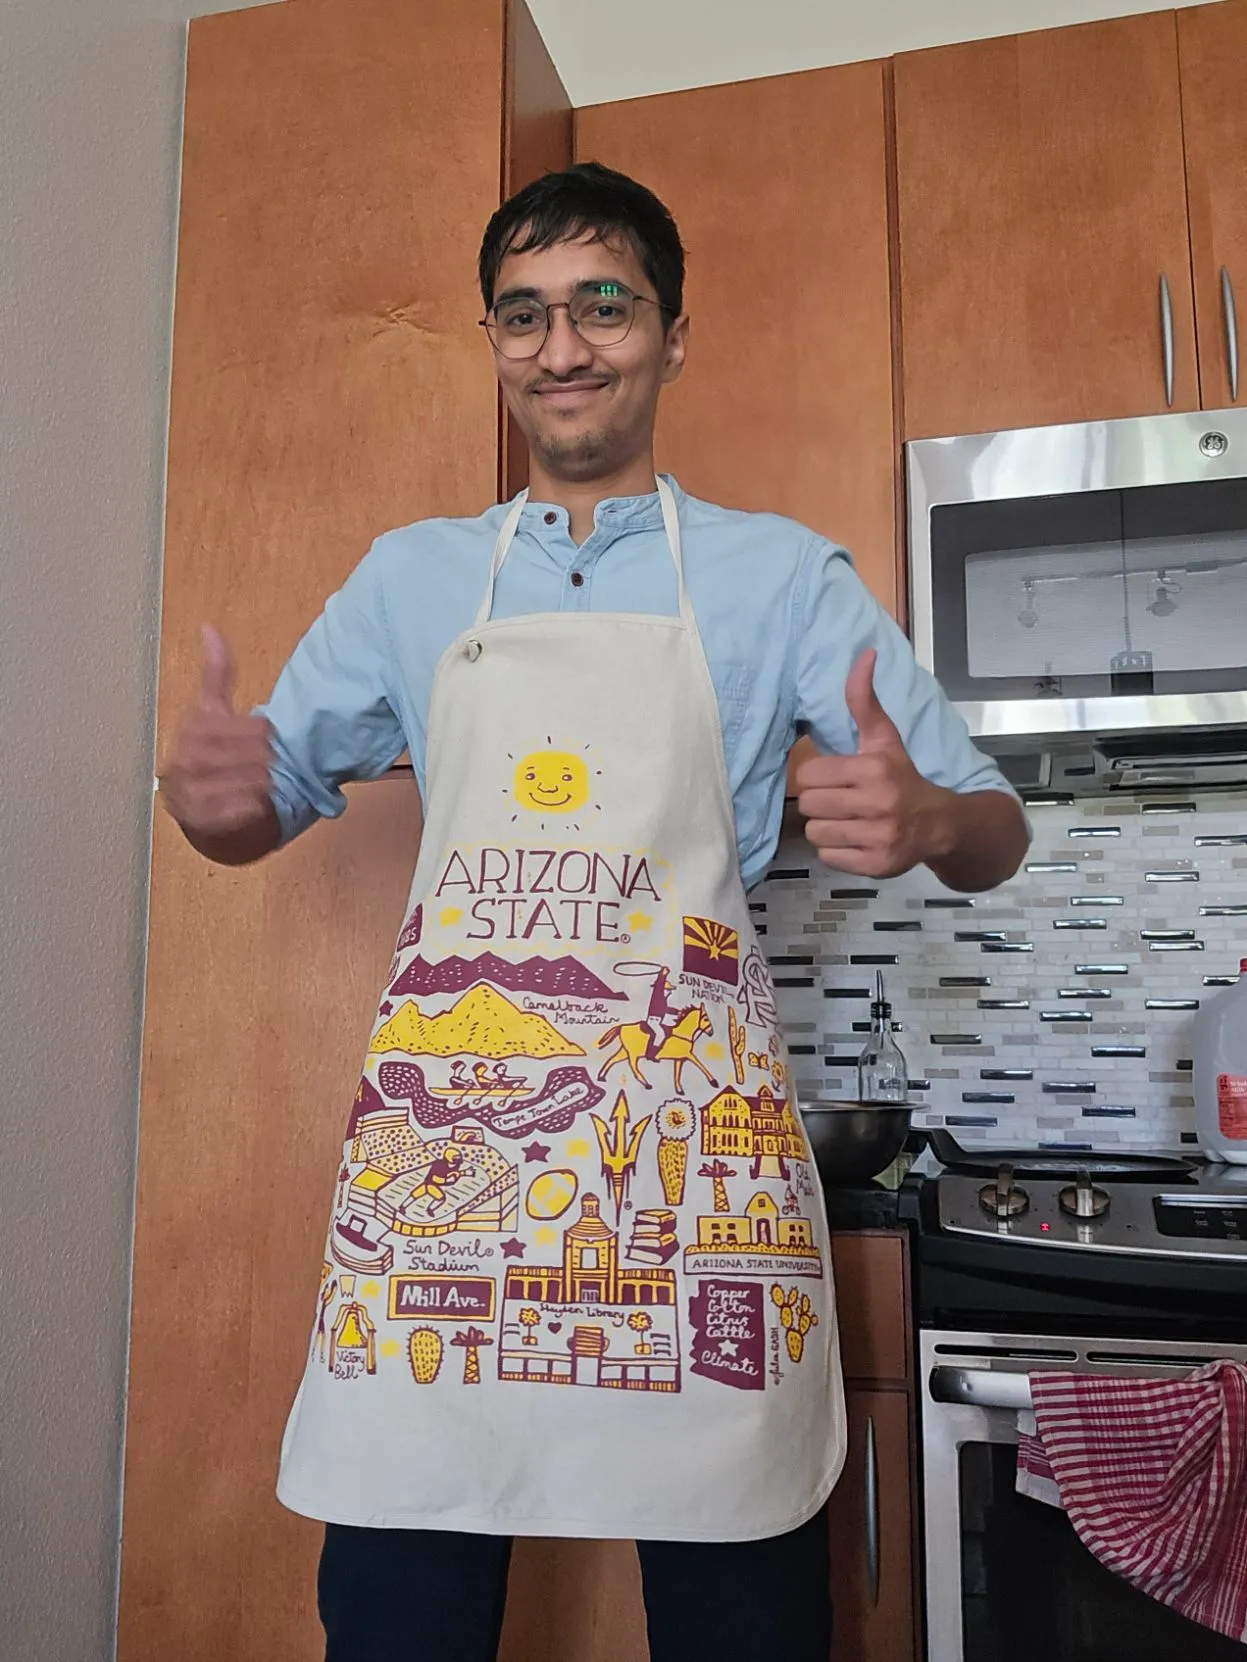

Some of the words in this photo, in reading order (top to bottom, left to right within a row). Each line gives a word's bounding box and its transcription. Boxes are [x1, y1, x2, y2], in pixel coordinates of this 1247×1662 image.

[435, 848, 661, 901] ARIZONA
[678, 973, 701, 988] SUN
[522, 996, 609, 1013] Camelback
[554, 1011, 620, 1025] Mountain
[527, 1103, 556, 1118] Town
[551, 1087, 585, 1106] Lake
[403, 1239, 432, 1255] Sun
[408, 1256, 480, 1273] Stadium
[692, 1258, 744, 1269] ARIZONA
[746, 1259, 774, 1269] STATE
[400, 1285, 440, 1308] Mill
[707, 1284, 751, 1306] Copper
[708, 1299, 756, 1314] Cotton
[540, 1303, 584, 1319] Hayden
[586, 1306, 625, 1328] Library
[706, 1312, 750, 1327] Citrus
[706, 1325, 756, 1339] Cattle
[336, 1350, 366, 1373] Victory
[701, 1350, 760, 1376] Climate
[334, 1364, 359, 1380] Bell
